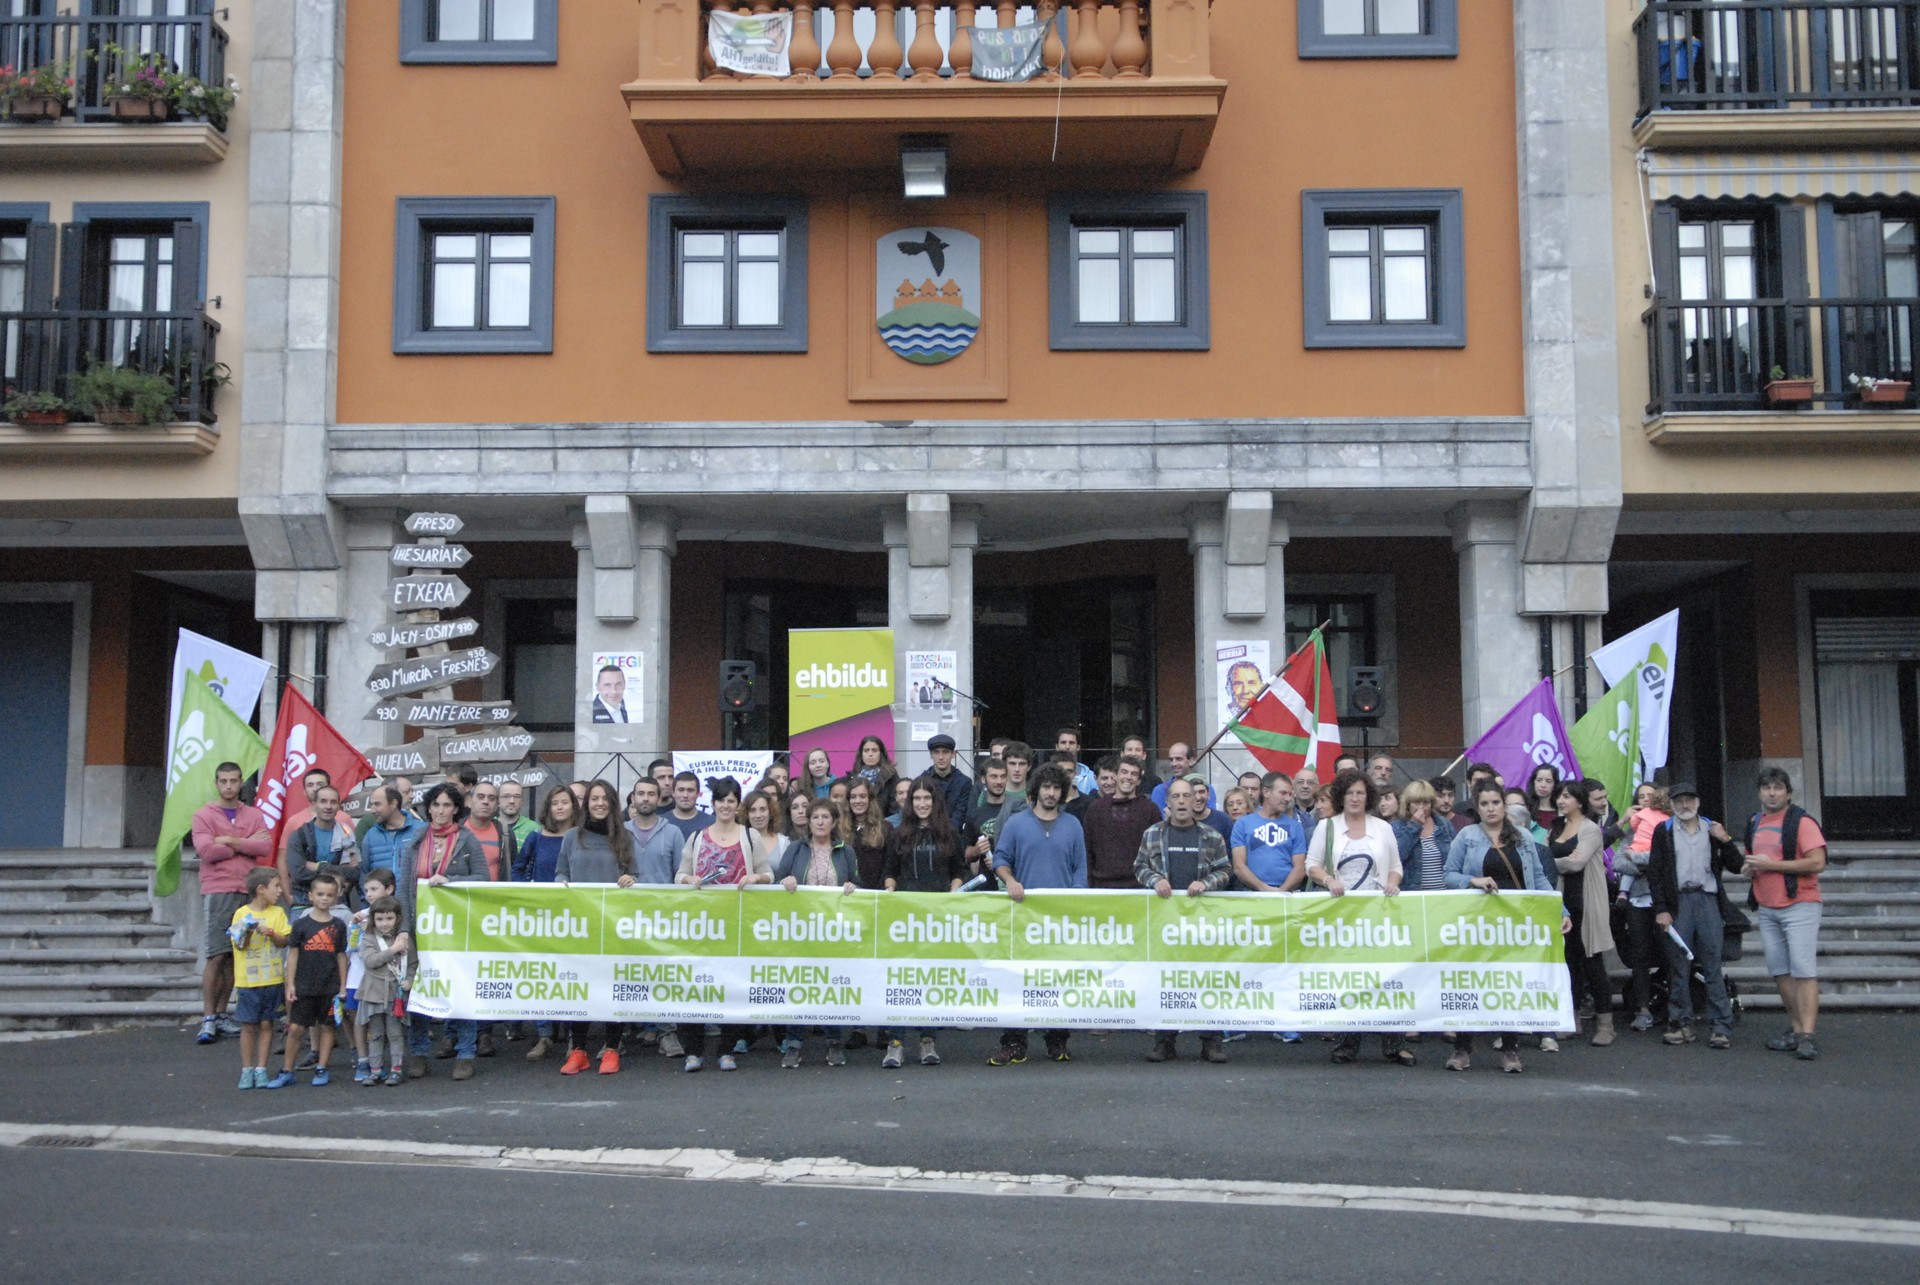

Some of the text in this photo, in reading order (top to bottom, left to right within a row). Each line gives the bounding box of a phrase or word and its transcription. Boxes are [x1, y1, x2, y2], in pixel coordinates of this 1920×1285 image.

[721, 47, 743, 62] AHT
[413, 517, 455, 530] PRESO
[394, 582, 455, 604] ETXERA
[467, 649, 485, 658] 930
[597, 656, 641, 667] OTEGI
[371, 678, 390, 692] 830
[441, 657, 490, 676] FRESNES
[795, 662, 888, 688] ehbildu
[377, 708, 398, 720] 930
[492, 708, 509, 720] 930
[445, 735, 531, 755] CLAIRVAUX 1050
[375, 752, 426, 770] HUELVA
[689, 760, 757, 769] EUSKAL PRESO
[523, 772, 542, 784] 1100
[705, 766, 760, 775] IHESLARIAK
[481, 907, 589, 938] ehbildu
[616, 909, 726, 940] ehbildu
[753, 911, 862, 942] ehbildu
[889, 913, 998, 944] ehbildu
[1025, 915, 1134, 945] ehbildu
[1161, 916, 1272, 946] ehbildu
[1440, 915, 1552, 946] ehbildu
[1300, 917, 1412, 947] ehbildu
[422, 968, 440, 978] eta
[478, 961, 578, 980] HEMEN eta
[614, 963, 714, 983] HEMEN eta
[750, 965, 850, 985] HEMEN eta
[887, 967, 987, 986] HEMEN eta
[1024, 969, 1124, 988] HEMEN eta
[1161, 970, 1262, 989] HEMEN eta
[476, 982, 512, 990] DENON
[613, 984, 648, 992] DENON
[1299, 971, 1403, 989] HEMEN eta
[1440, 971, 1545, 989] HEMEN eta
[476, 991, 512, 999] HERRIA
[516, 981, 588, 1000] ORAIN
[613, 993, 648, 1001] HERRIA
[652, 984, 724, 1003] ORAIN
[750, 987, 785, 995] DENON
[789, 986, 861, 1005] ORAIN
[886, 988, 922, 996] DENON
[926, 988, 998, 1006] ORAIN
[1023, 990, 1059, 998] DENON
[1063, 989, 1135, 1008] ORAIN
[1161, 992, 1196, 1000] DENON
[1300, 993, 1336, 1001] DENON
[1441, 993, 1478, 1001] DENON
[749, 996, 785, 1004] HERRIA
[1023, 999, 1059, 1007] HERRIA
[1161, 1001, 1197, 1009] HERRIA
[1201, 991, 1274, 1009] ORAIN
[1300, 1002, 1336, 1010] HERRIA
[1341, 992, 1415, 1010] ORAIN
[1442, 1002, 1479, 1010] HERRIA
[1483, 991, 1558, 1011] ORAIN
